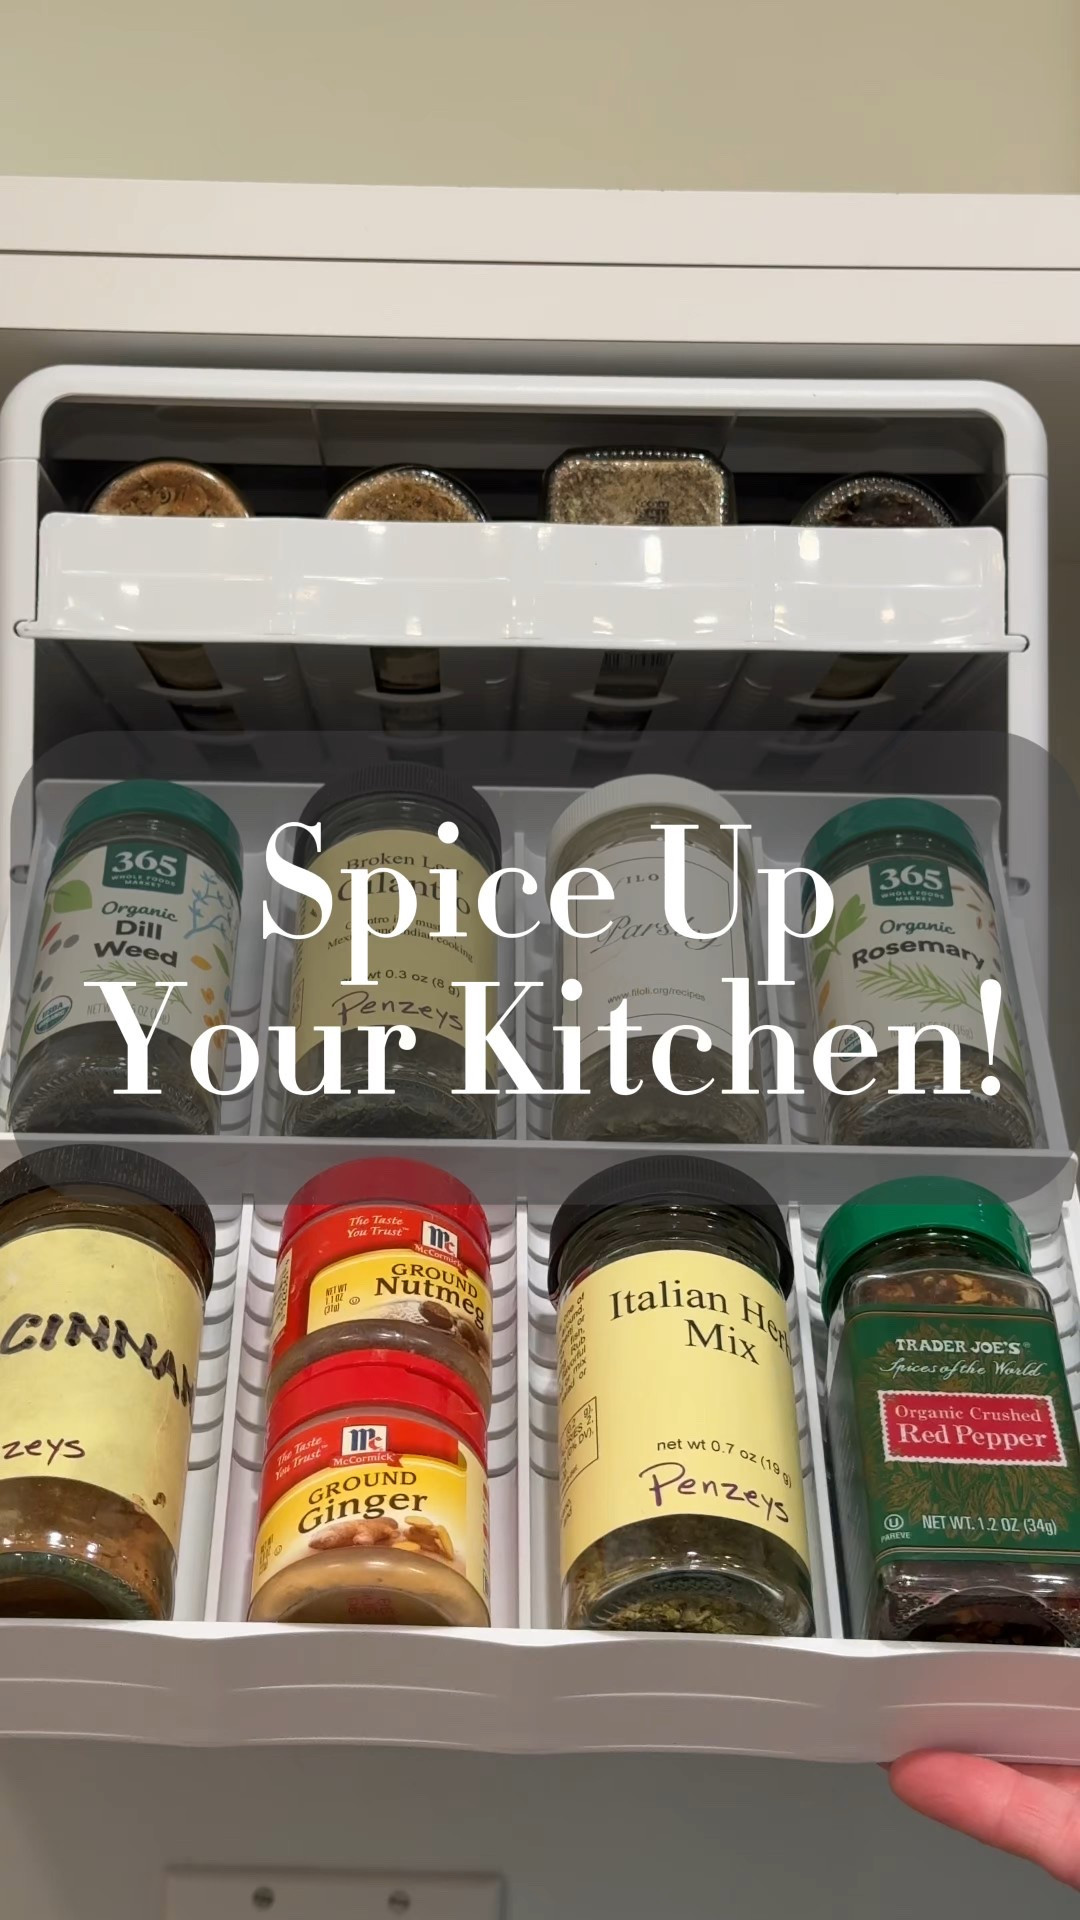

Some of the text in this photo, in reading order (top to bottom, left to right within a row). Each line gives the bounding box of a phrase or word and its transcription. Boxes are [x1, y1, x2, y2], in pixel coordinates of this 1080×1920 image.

[111, 850, 178, 878] 365
[346, 852, 415, 870] Broken
[124, 879, 161, 889] MARKET
[146, 875, 176, 887] FOODS
[879, 864, 943, 891] 365
[881, 890, 945, 900] WHOLE FOODS
[895, 895, 932, 903] MARKET
[101, 901, 178, 922] Organic
[115, 919, 162, 941] Dill
[880, 919, 956, 935] Organic
[93, 940, 178, 968] Weed
[852, 940, 985, 970] Rosemary
[385, 969, 408, 980] 0.3
[411, 973, 429, 984] oz
[432, 977, 446, 989] (8
[448, 984, 461, 999] g)
[331, 990, 464, 1031] Penzeys
[349, 1214, 405, 1227] The Taste
[346, 1227, 369, 1239] You
[325, 1285, 338, 1297] NET
[391, 1262, 479, 1300] GROUND
[374, 1275, 485, 1331] Nutmeg
[609, 1278, 731, 1322] Italian
[570, 1336, 586, 1356] Rub
[684, 1318, 760, 1365] Mix
[895, 1338, 966, 1354] TRADER
[879, 1357, 1049, 1380] Spices of the World
[895, 1404, 1043, 1424] Organic Crushed
[896, 1422, 1048, 1451] Red Pepper
[277, 1436, 323, 1467] The Taste
[275, 1464, 291, 1481] You
[656, 1438, 793, 1489] net wt 0.7 oz (19 g)
[308, 1470, 418, 1506] GROUND
[638, 1461, 790, 1523] Penzeys
[297, 1492, 429, 1535] Ginger
[880, 1531, 912, 1543] PAREVE
[922, 1515, 1058, 1537] NET WT. 1.2 OZ (34g)
